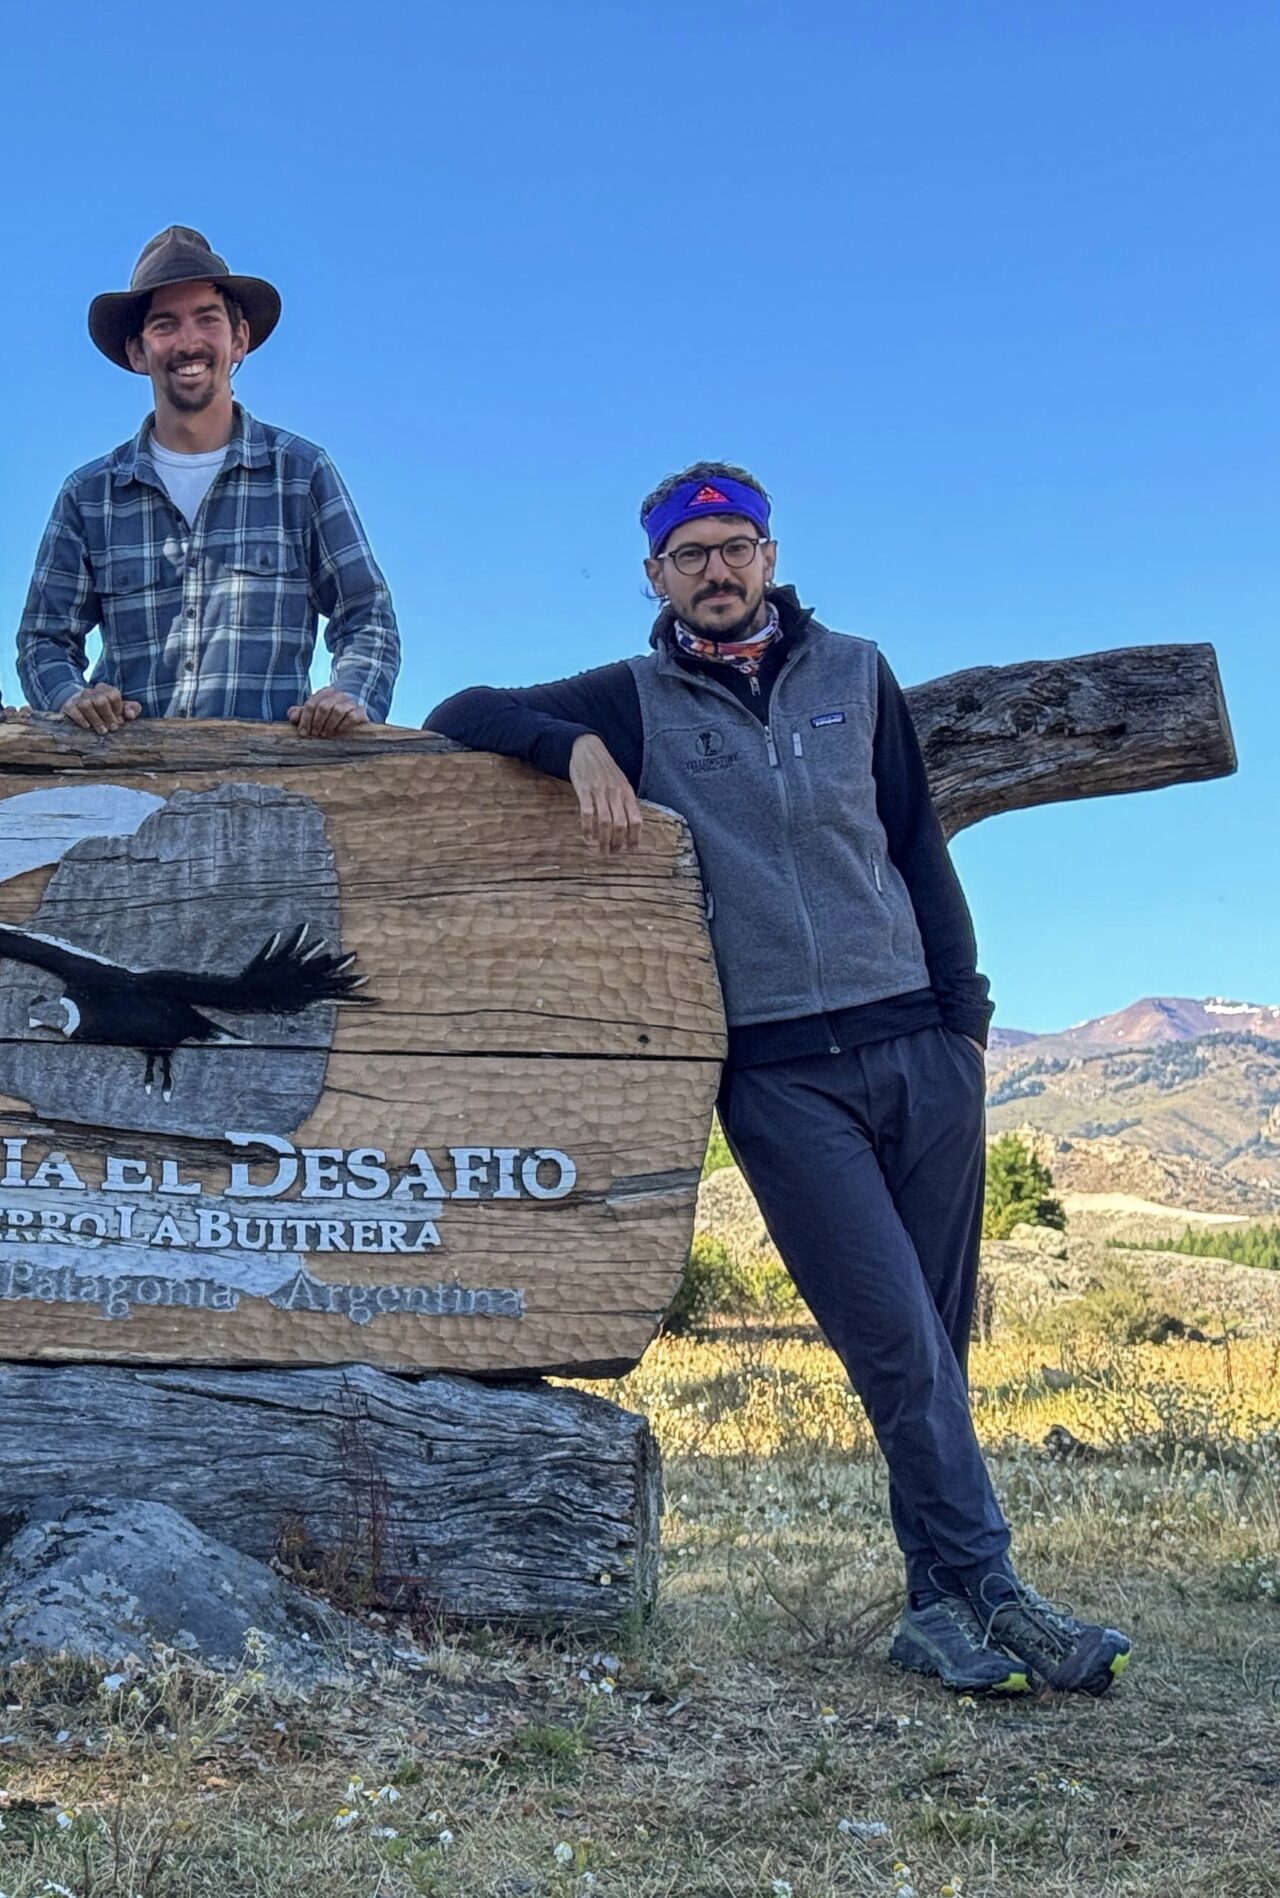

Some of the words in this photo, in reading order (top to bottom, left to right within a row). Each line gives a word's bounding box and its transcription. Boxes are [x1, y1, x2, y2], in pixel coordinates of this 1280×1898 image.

[101, 1156, 202, 1195] EL
[223, 1131, 578, 1200] DESAFIO
[114, 1206, 188, 1247] LA
[195, 1208, 443, 1253] BUITRERA
